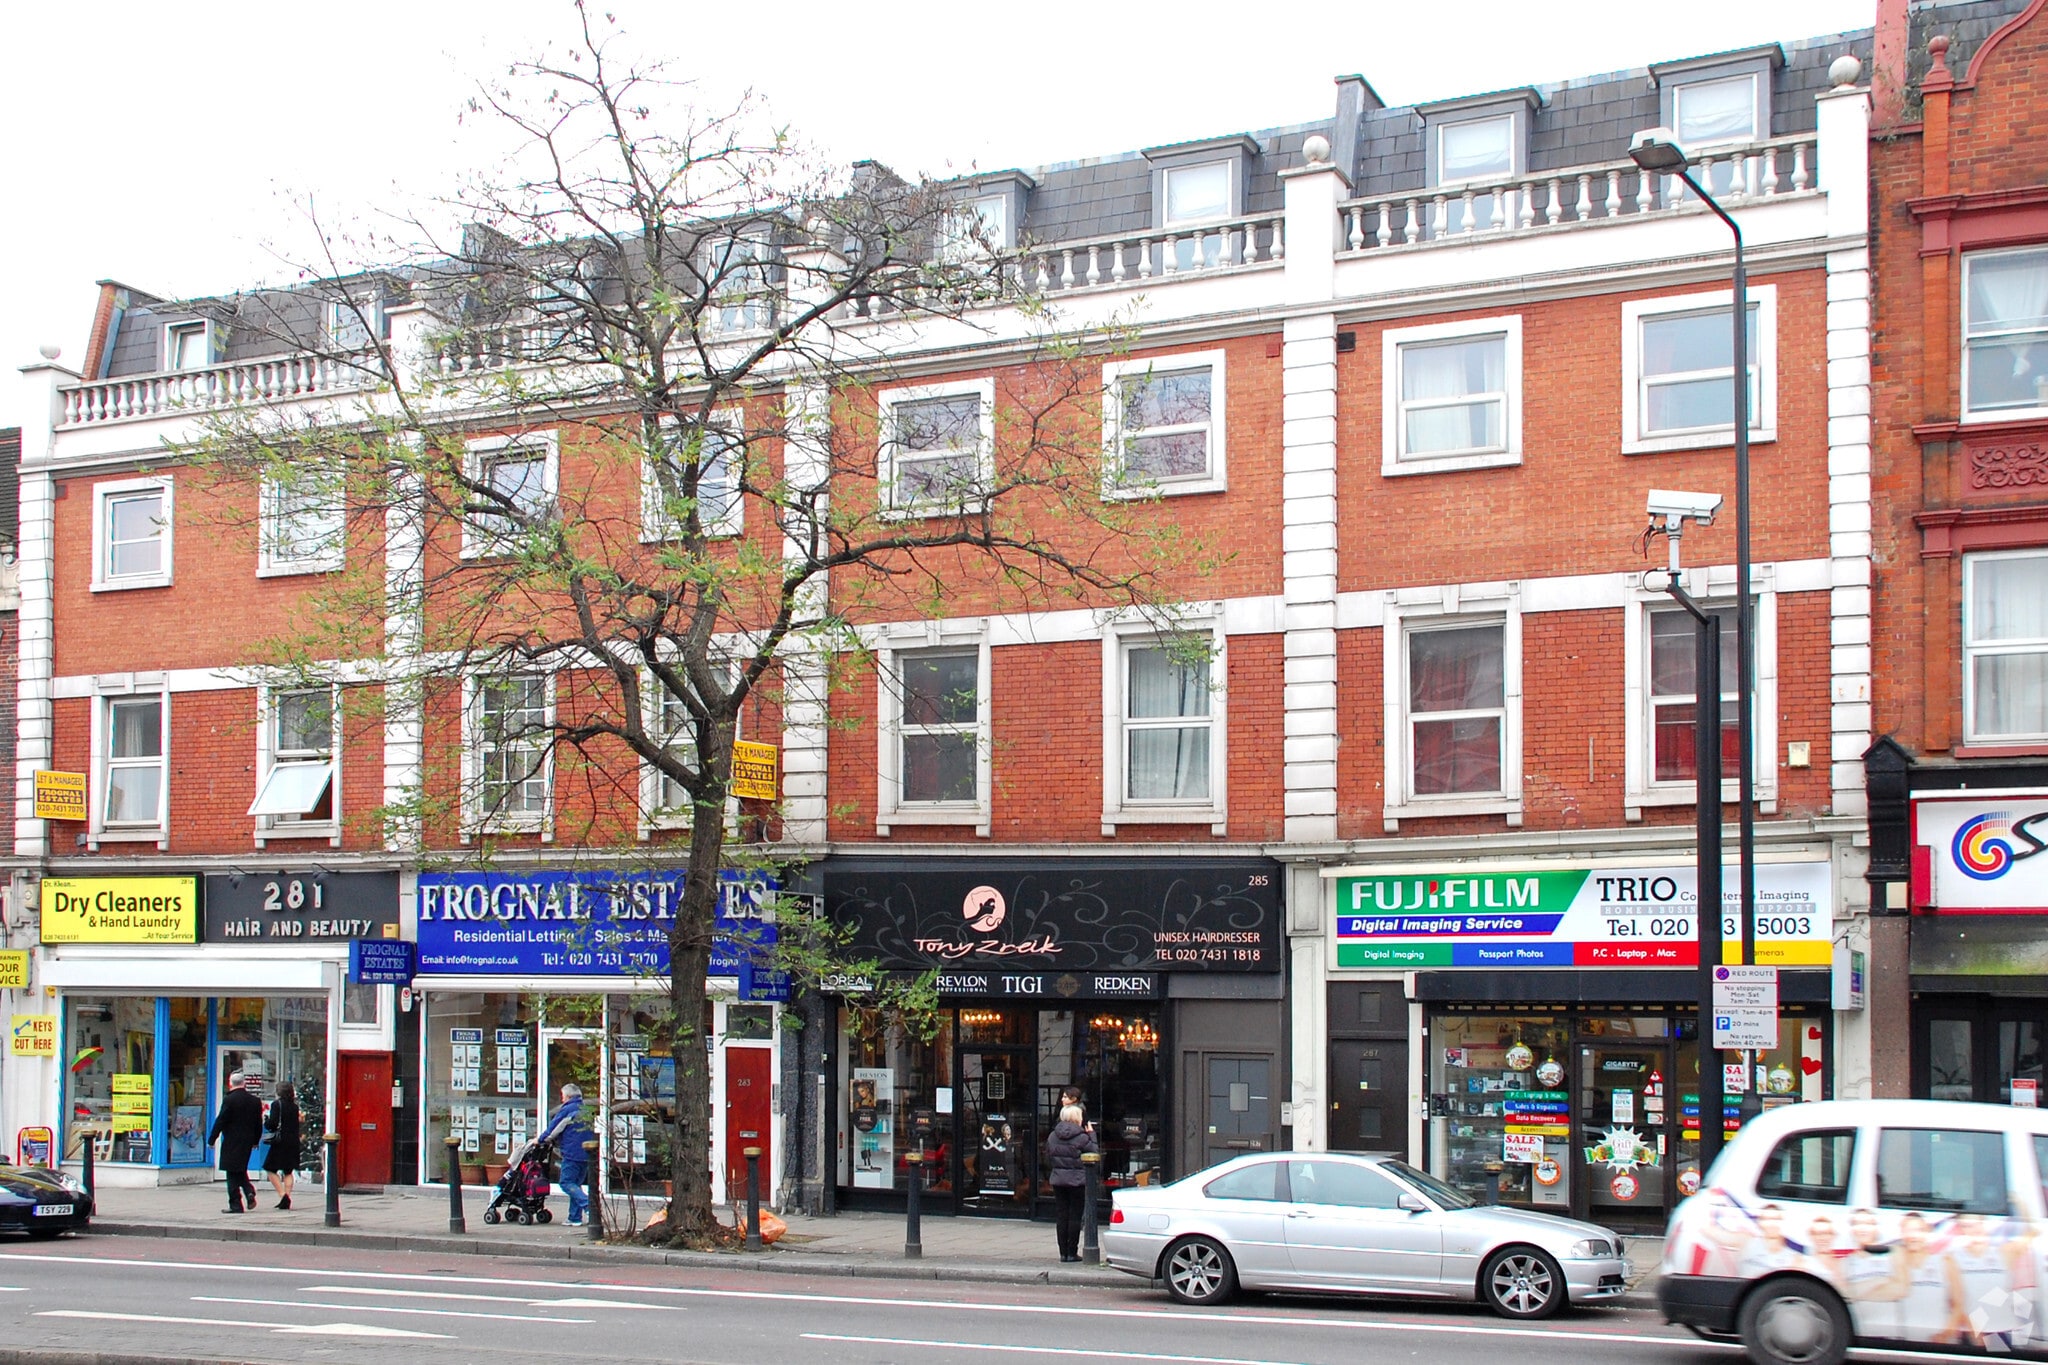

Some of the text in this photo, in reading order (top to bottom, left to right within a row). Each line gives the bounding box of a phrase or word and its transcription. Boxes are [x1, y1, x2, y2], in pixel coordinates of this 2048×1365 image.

[735, 762, 773, 773] FROGNAL
[37, 775, 47, 783] LET
[55, 776, 83, 785] MANAGED
[735, 770, 773, 780] ESTATES
[39, 789, 82, 797] FROGNAL
[1248, 875, 1269, 886] 285
[263, 880, 322, 911] 281
[1352, 878, 1539, 910] FUJIFILM
[1596, 877, 1677, 902] TRIO
[1759, 890, 1810, 901] Imaging
[55, 891, 182, 918] Dry Cleaners
[419, 880, 768, 921] FROGNAL ESTES
[1605, 906, 1642, 914] HOME
[1659, 906, 1698, 914] BUSIN
[1758, 904, 1812, 913] UPPORT
[88, 916, 181, 930] & Hand Laundry
[270, 919, 304, 937] AND
[309, 919, 372, 937] BEAUTY
[1351, 917, 1523, 933] Digital Imaging Service
[1606, 919, 1643, 936] Tel.
[1650, 918, 1689, 936] 020
[1757, 917, 1811, 935] 5003
[170, 932, 193, 940] Service
[454, 930, 526, 943] Residential
[594, 930, 631, 943] Sales
[634, 931, 644, 942] &
[1153, 932, 1261, 943] UNISEX HAIRDRESSER
[361, 943, 408, 956] FROGNAL
[913, 938, 975, 959] Tony
[1479, 949, 1545, 960] Passport Photos
[1617, 949, 1648, 959] Laptop
[1657, 949, 1677, 958] Mac
[422, 956, 445, 964] Email:
[446, 956, 519, 967] info@frognal.co.uk
[541, 952, 564, 966] Tel:
[569, 953, 592, 966] 020
[596, 953, 623, 966] 7431
[1155, 949, 1261, 961] TEL 020 7431 1818
[1364, 950, 1425, 960] Digital Imaging
[363, 957, 405, 969] ESTATES
[936, 975, 988, 987] REVLON
[1001, 976, 1043, 993] TIGI
[1094, 977, 1151, 990] REDKEN
[33, 1021, 53, 1032] KEYS
[1718, 1018, 1729, 1029] P
[15, 1039, 52, 1050] CUT HERE
[1505, 1135, 1536, 1145] SALE
[41, 1206, 55, 1215] TSY
